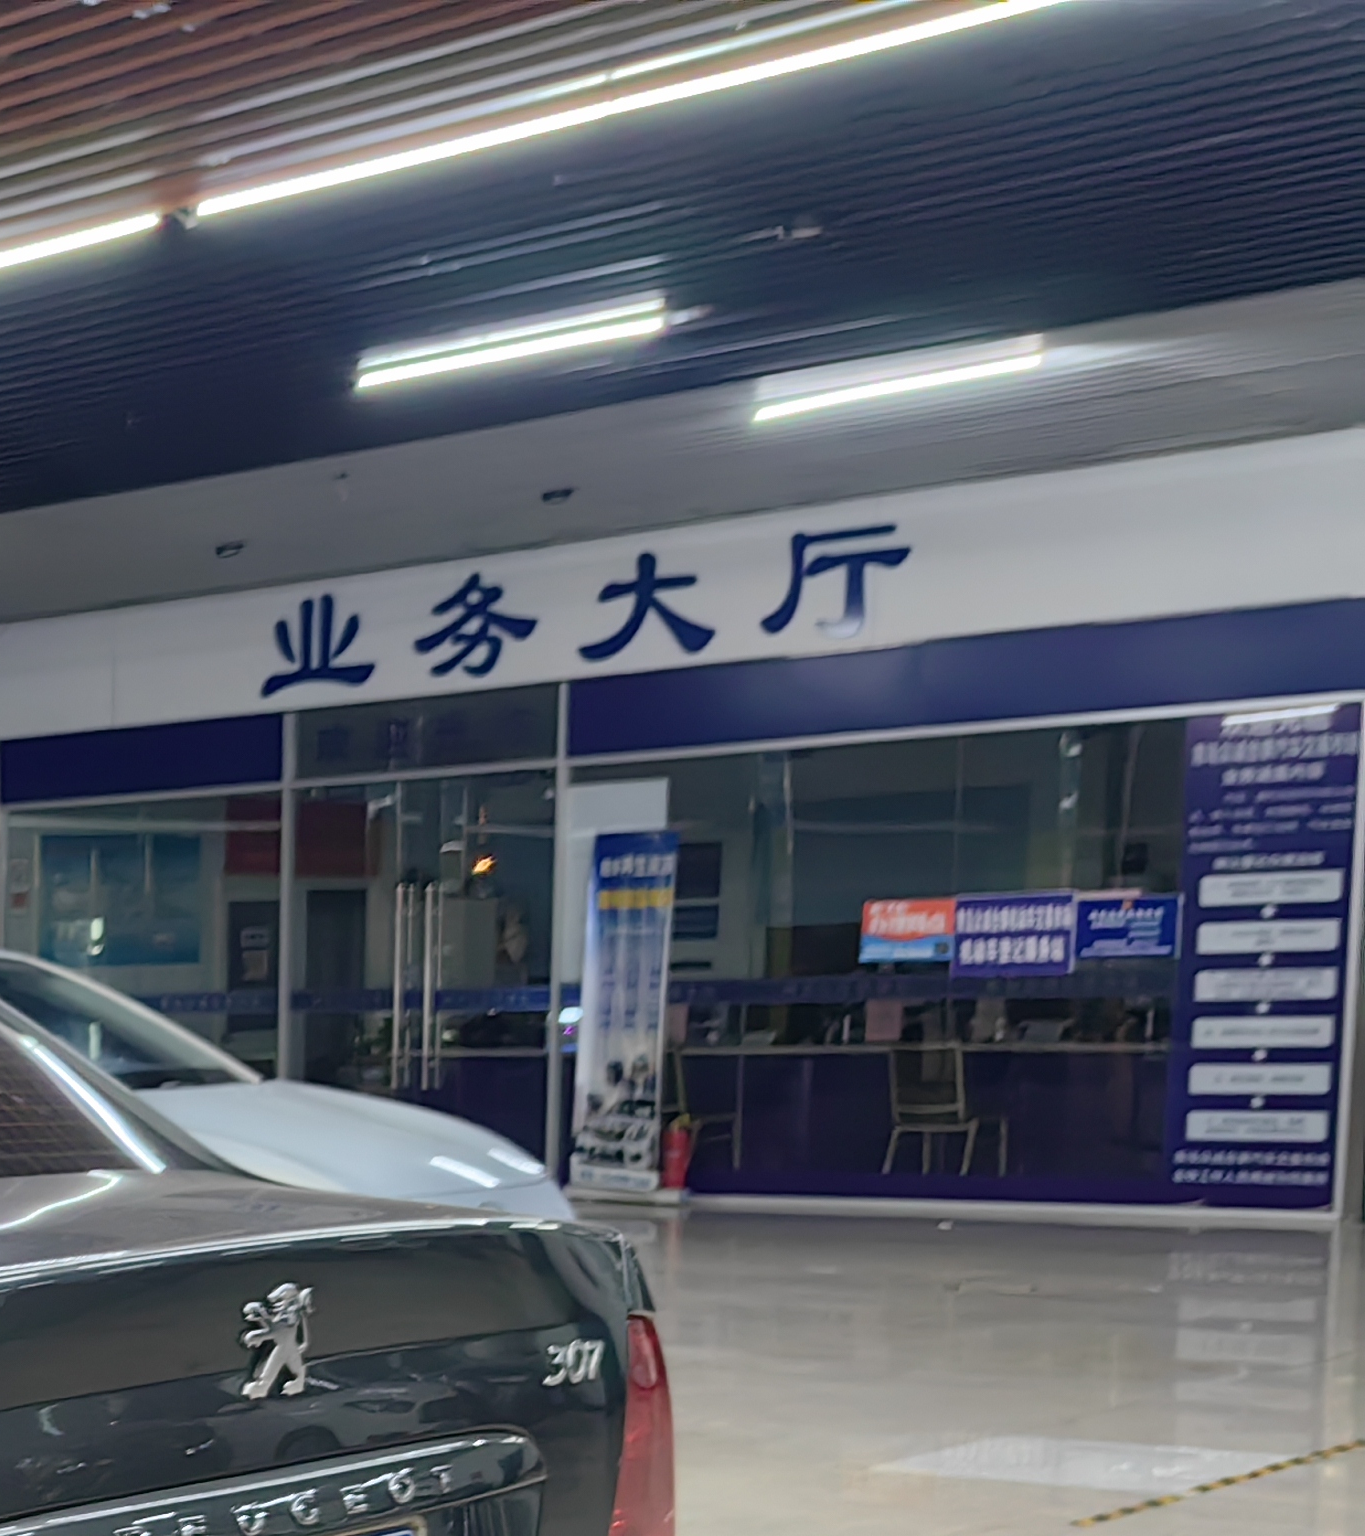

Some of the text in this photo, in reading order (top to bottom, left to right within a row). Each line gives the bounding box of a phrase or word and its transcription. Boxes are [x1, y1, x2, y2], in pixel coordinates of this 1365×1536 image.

[261, 524, 912, 698] 业务大厅
[541, 1338, 606, 1387] 307
